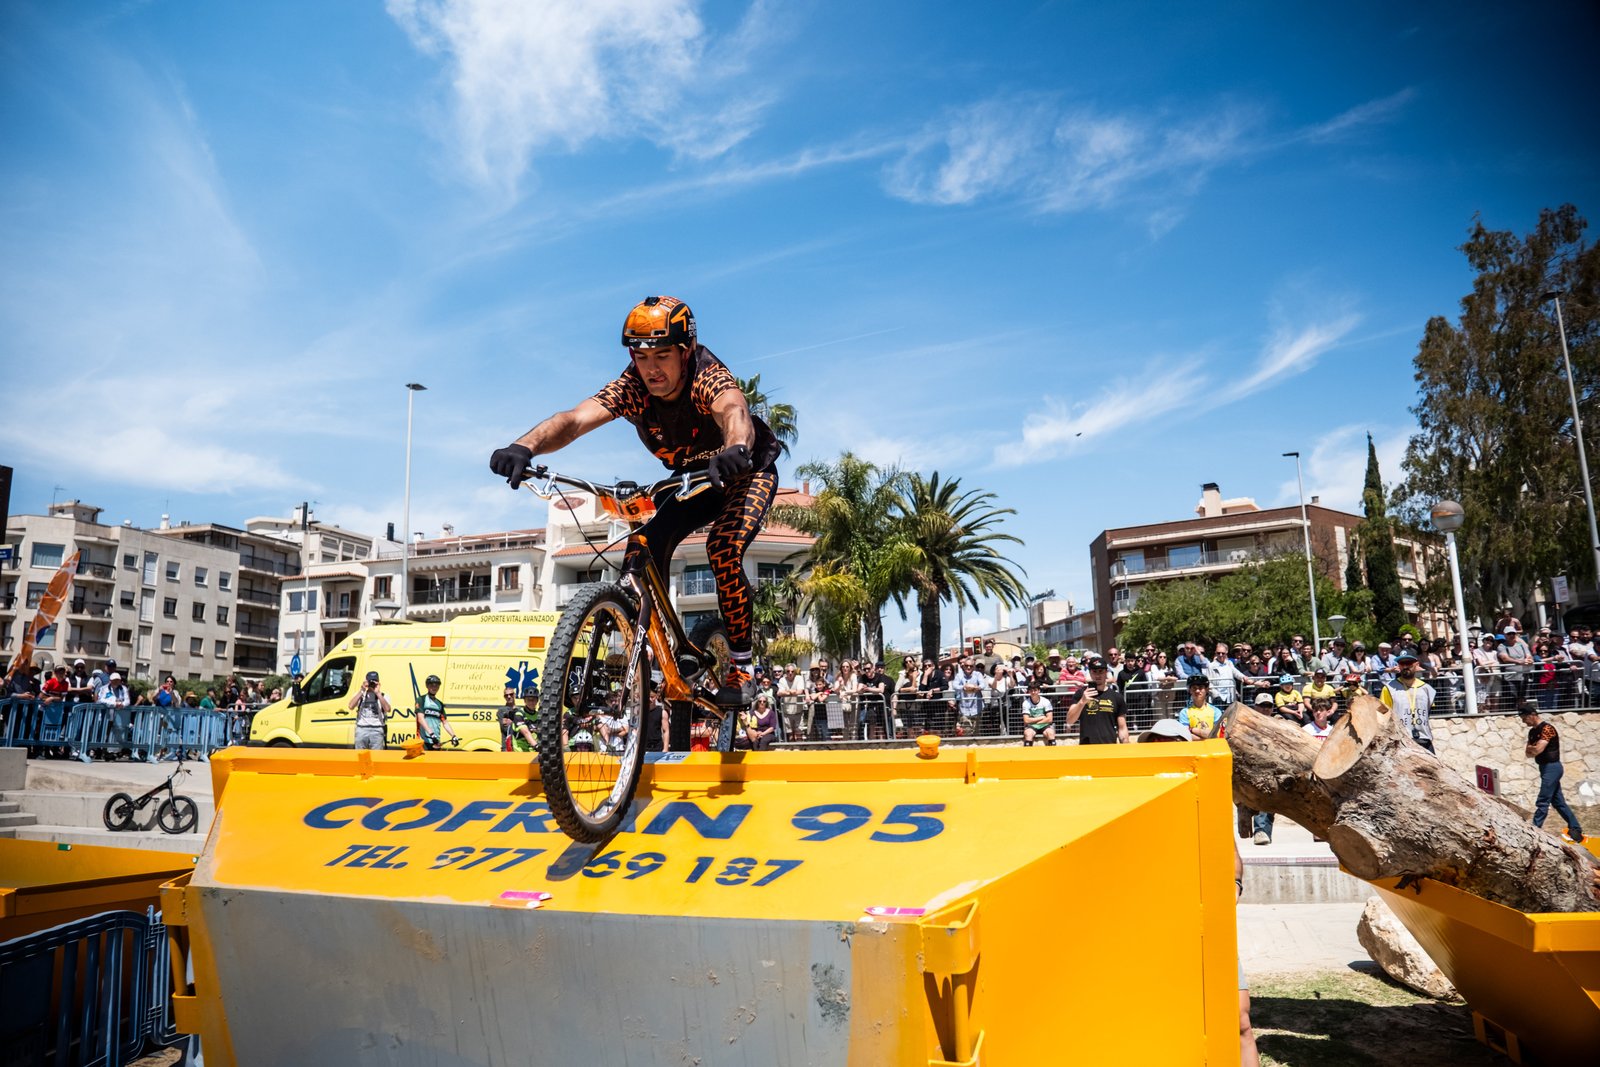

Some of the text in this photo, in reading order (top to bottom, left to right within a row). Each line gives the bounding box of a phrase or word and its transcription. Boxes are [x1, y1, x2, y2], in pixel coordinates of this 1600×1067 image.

[480, 615, 555, 623] SOPORTE VITAL AVANZADO
[468, 672, 484, 681] del
[472, 711, 492, 721] 658
[791, 803, 947, 843] 95
[323, 844, 804, 887] TEL. 977 369 187
